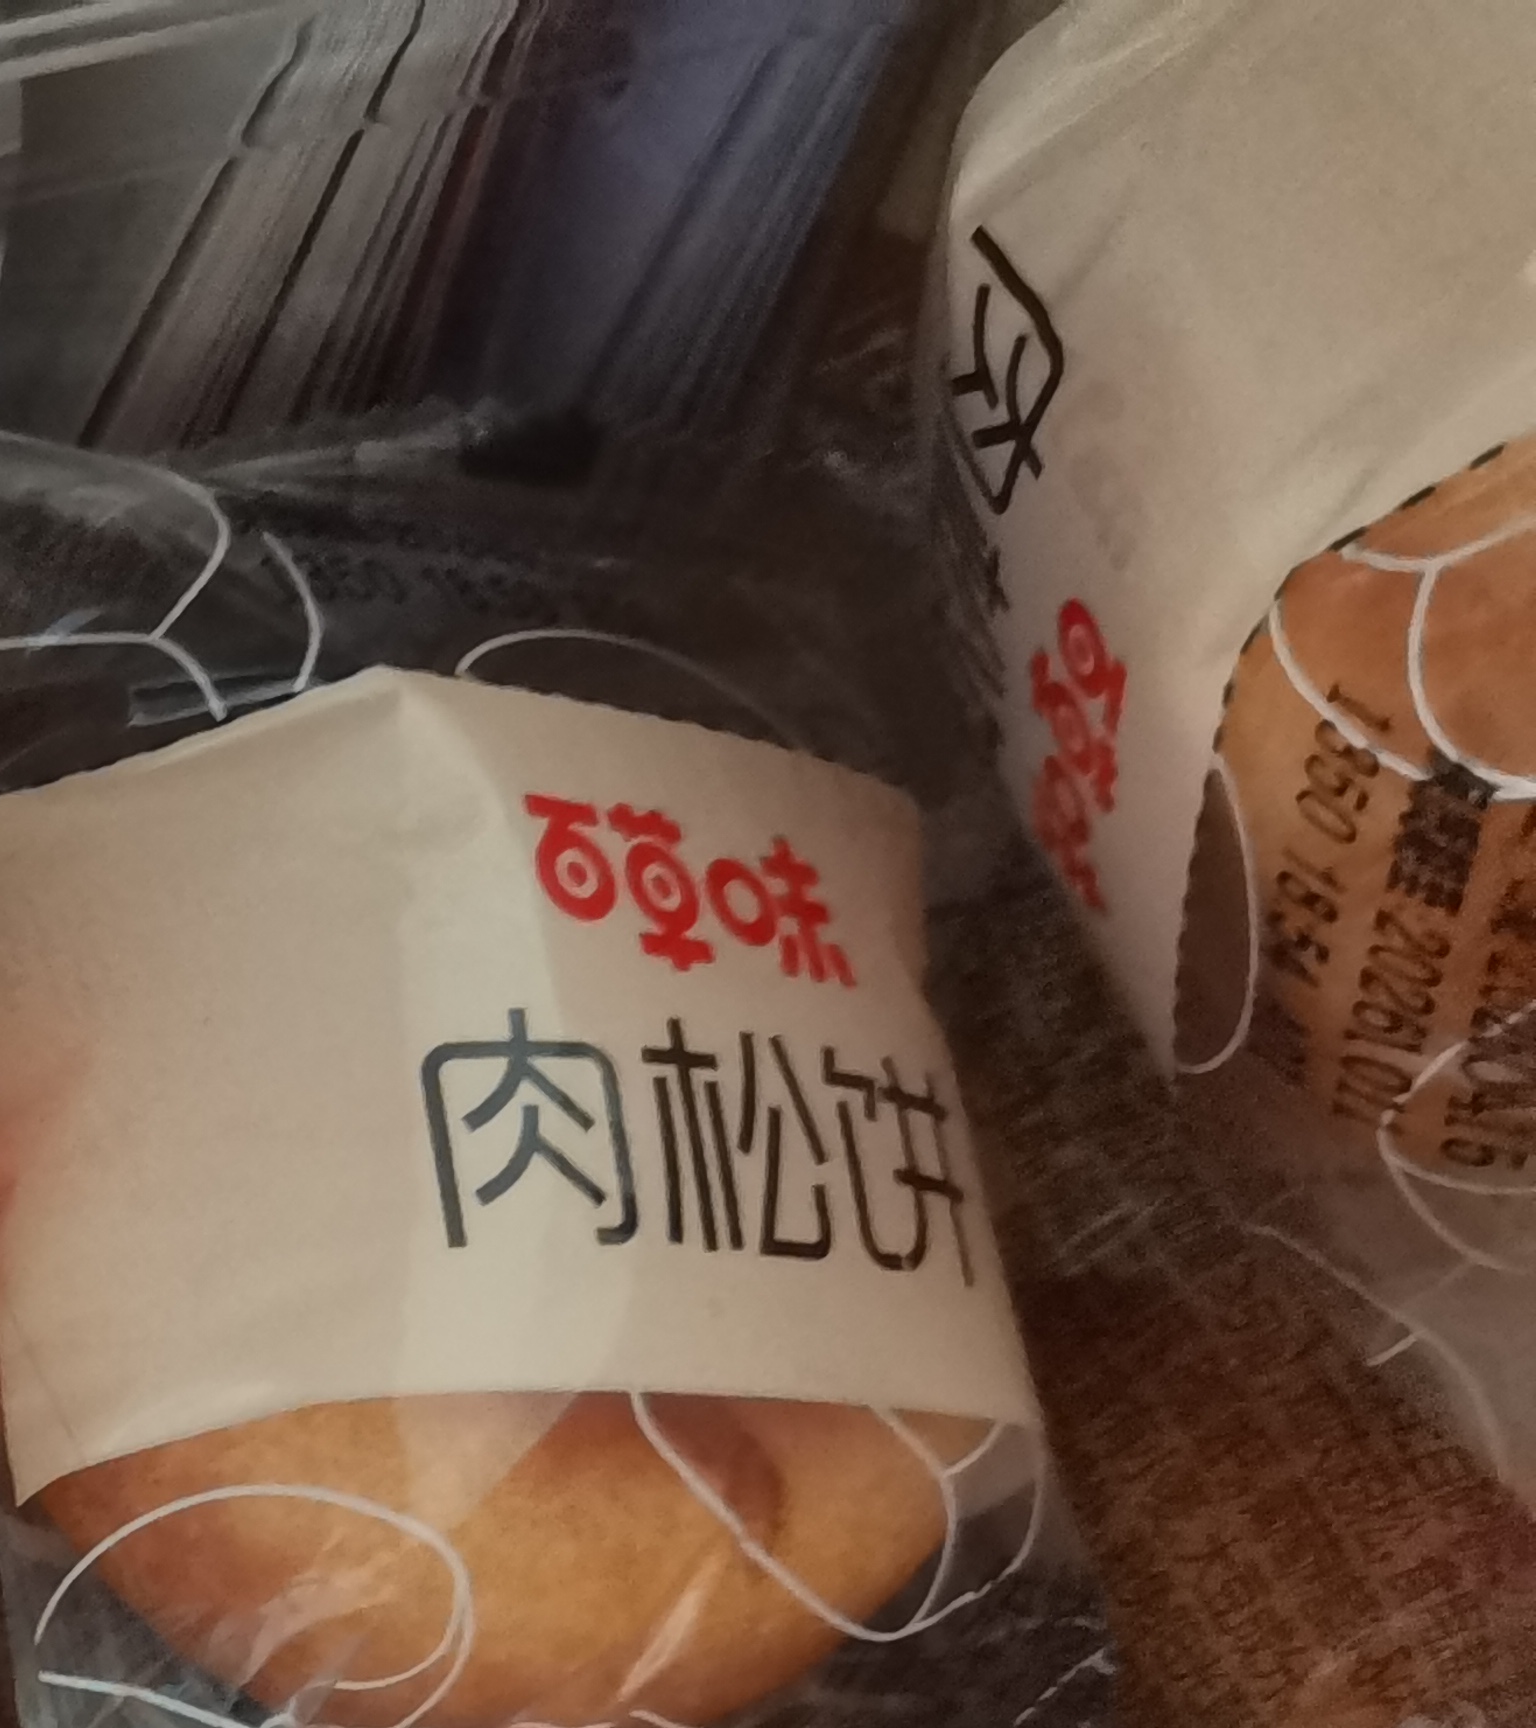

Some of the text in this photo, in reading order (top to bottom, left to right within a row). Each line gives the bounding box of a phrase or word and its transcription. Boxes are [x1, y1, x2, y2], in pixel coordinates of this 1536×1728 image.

[522, 794, 858, 990] 百草味
[419, 1009, 977, 1289] 肉松饼
